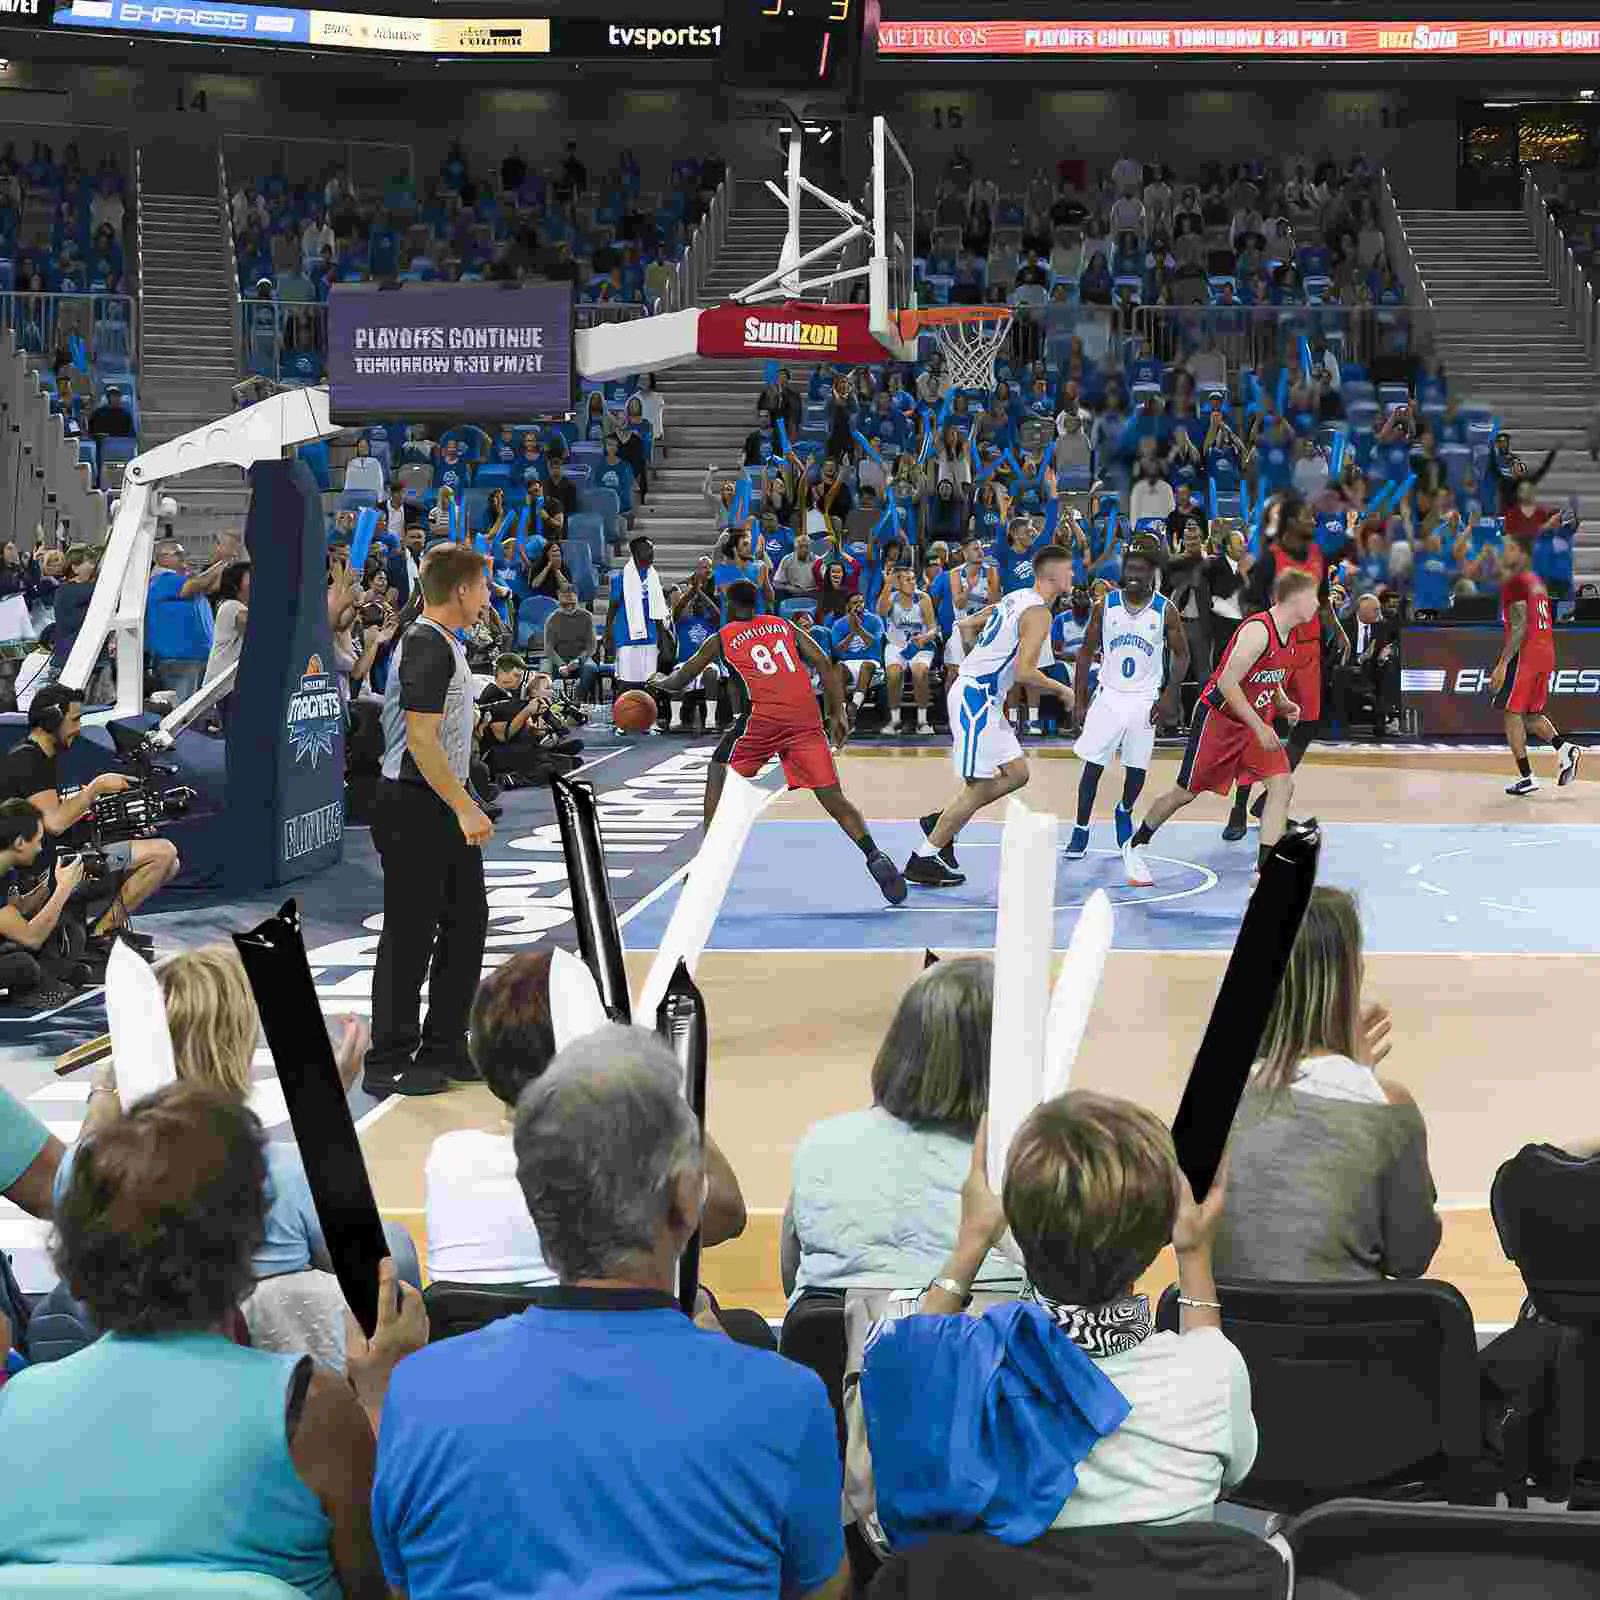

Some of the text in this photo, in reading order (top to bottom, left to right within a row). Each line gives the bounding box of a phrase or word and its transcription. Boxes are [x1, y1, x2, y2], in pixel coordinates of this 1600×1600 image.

[608, 25, 721, 49] tvsports1
[1024, 29, 1094, 47] PLAYOFFS
[1097, 29, 1169, 47] CONTINUE
[1174, 29, 1262, 47] TOMORROW
[1488, 29, 1558, 48] PLAYOFFS
[355, 327, 544, 349] PLAYOFFS CONTINUE
[744, 315, 838, 346] Sumizon
[354, 354, 449, 374] TOMORROW
[493, 353, 543, 373] PM/ET
[751, 639, 797, 674] 81
[1122, 656, 1136, 679] 0
[288, 692, 341, 721] MAGNETS
